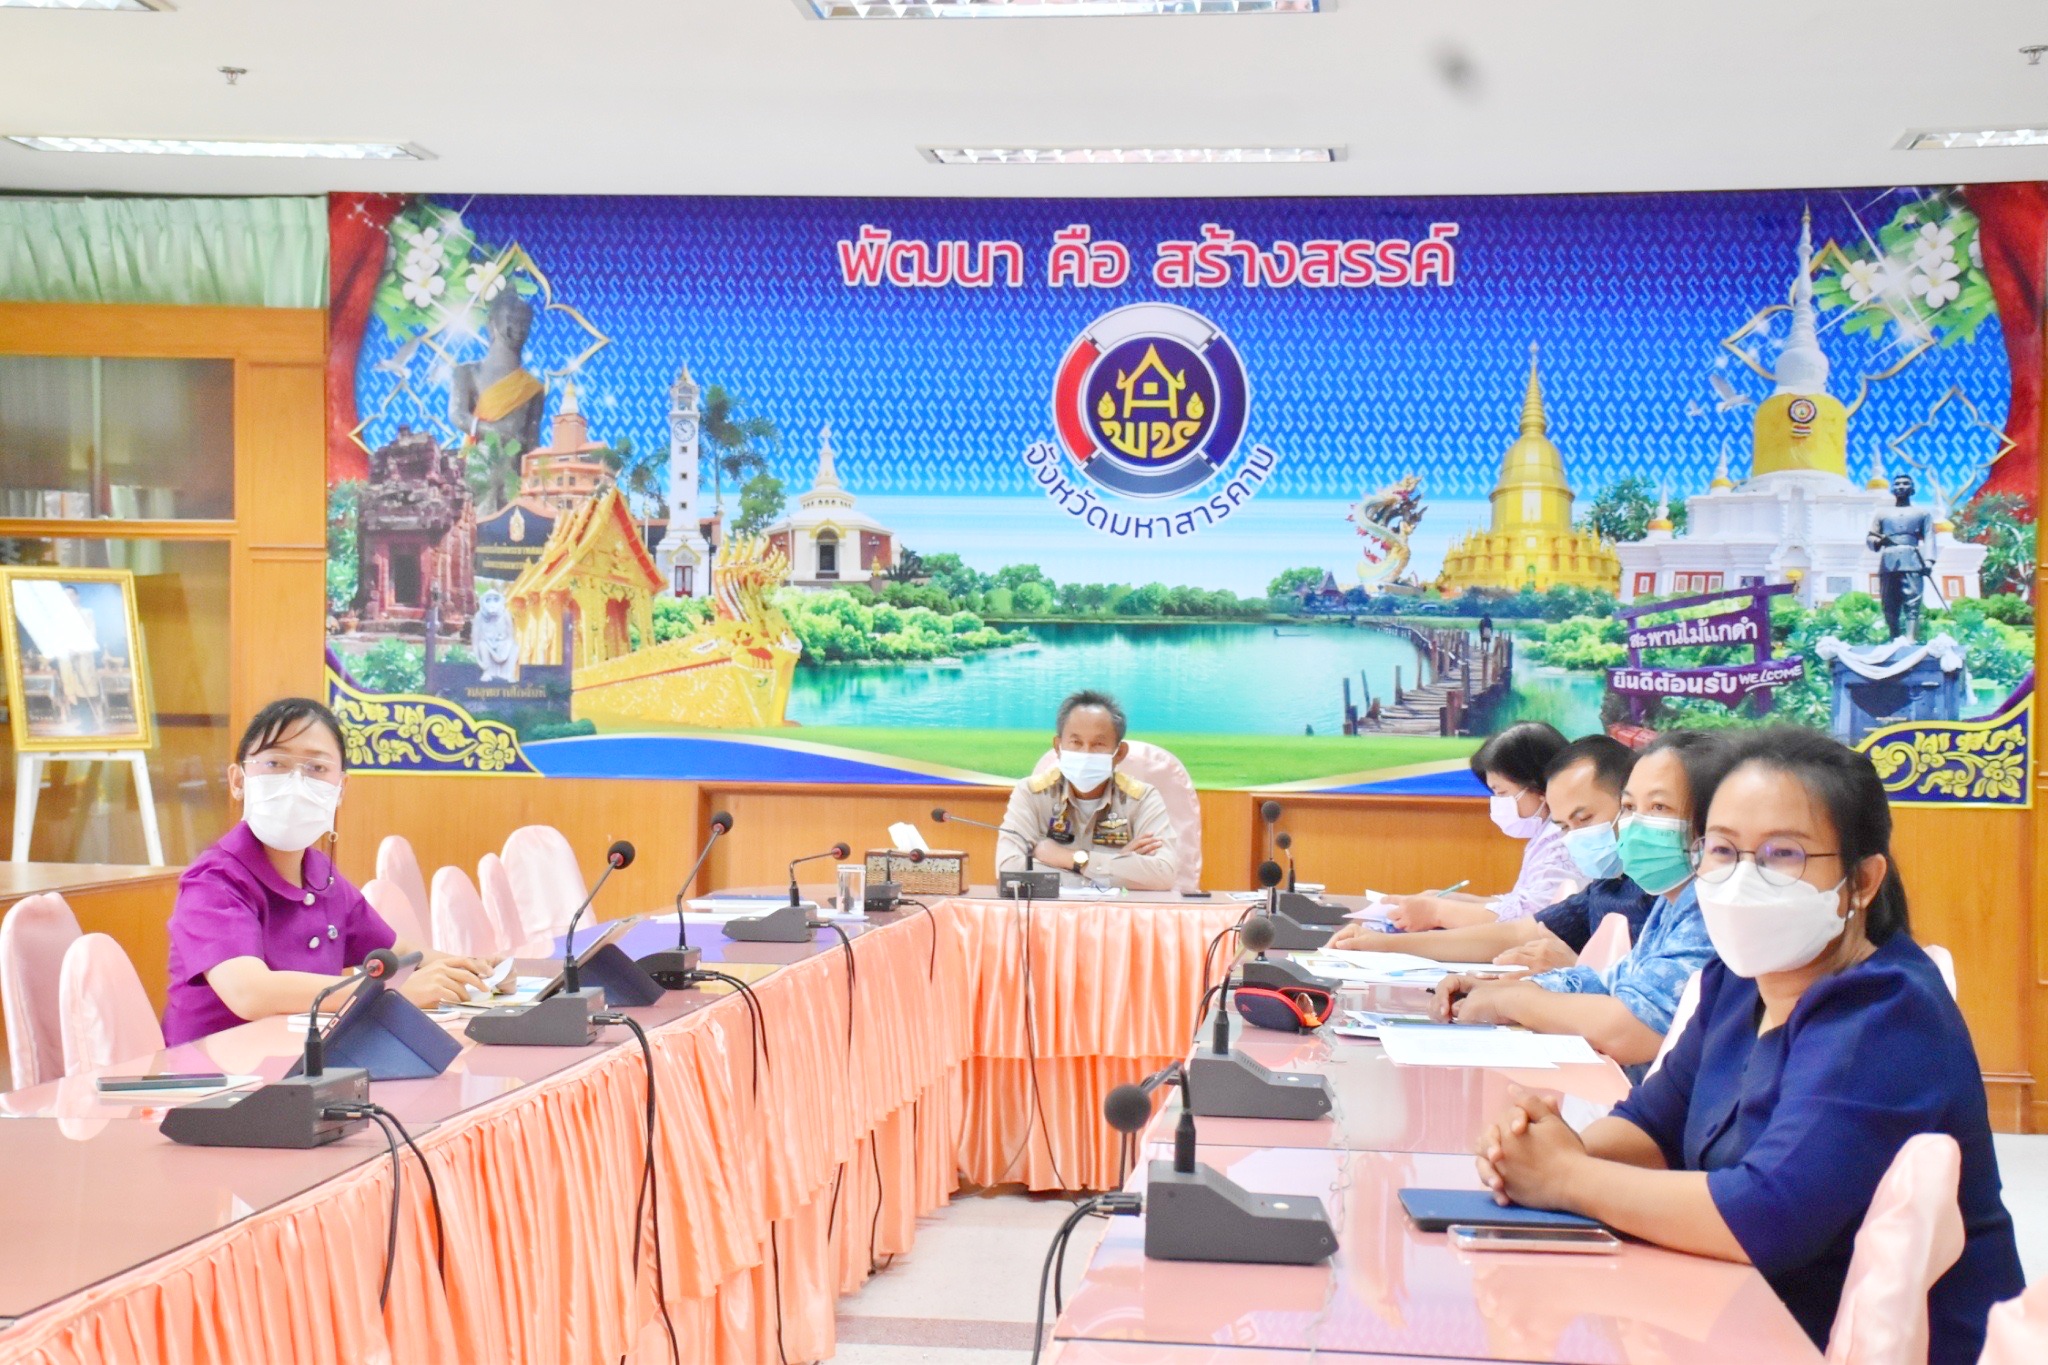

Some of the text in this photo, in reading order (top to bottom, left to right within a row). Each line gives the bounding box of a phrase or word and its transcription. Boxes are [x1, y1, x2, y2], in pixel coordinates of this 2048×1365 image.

[838, 222, 1460, 288] พัฒนา คือ สร้างสรรค์
[1025, 442, 1276, 539] จังหวัดมหาสารคาม
[1629, 616, 1758, 648] สะพานไม้แกดำ
[1613, 665, 1803, 695] ยินดีต้อนรับ WELCOME
